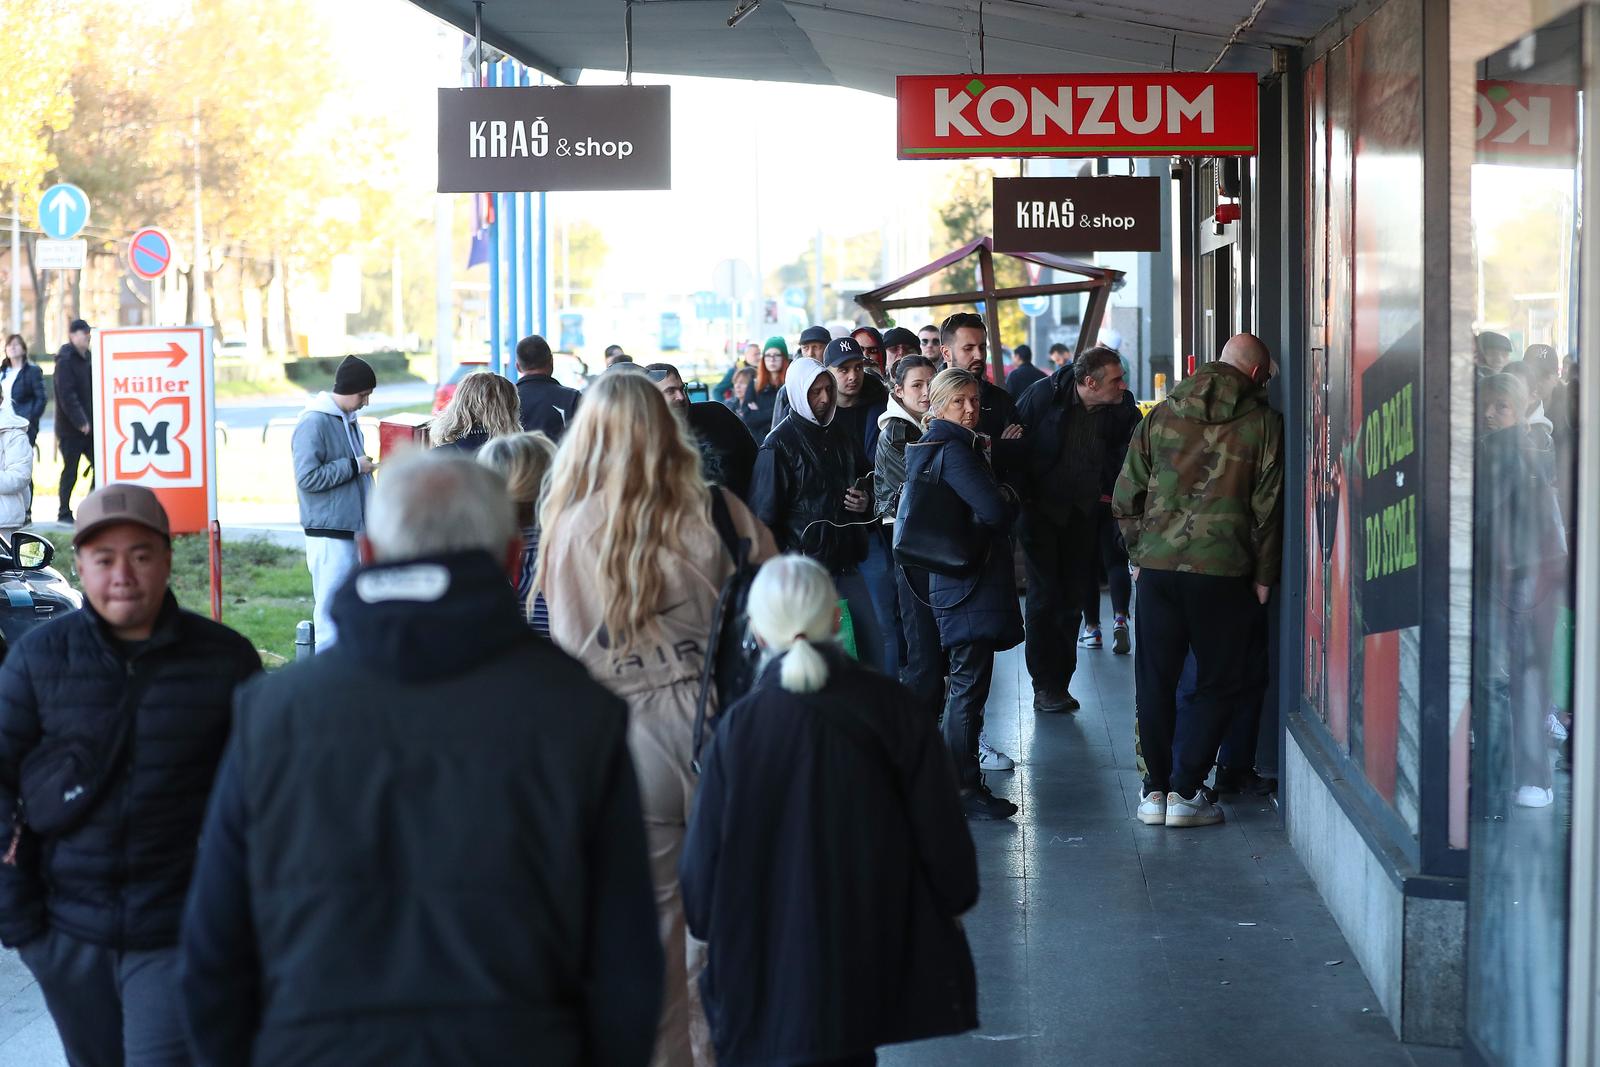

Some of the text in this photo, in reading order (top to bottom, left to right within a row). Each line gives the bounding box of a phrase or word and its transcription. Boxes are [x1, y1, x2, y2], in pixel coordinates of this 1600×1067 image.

[934, 84, 1215, 137] KONZUM
[469, 116, 549, 158] KRAŠ
[1016, 198, 1075, 229] KRAŠ
[839, 340, 852, 352] NY
[113, 376, 190, 394] Müller
[130, 421, 170, 456] M
[1365, 408, 1381, 480] OD
[1365, 494, 1418, 582] DO STOLA
